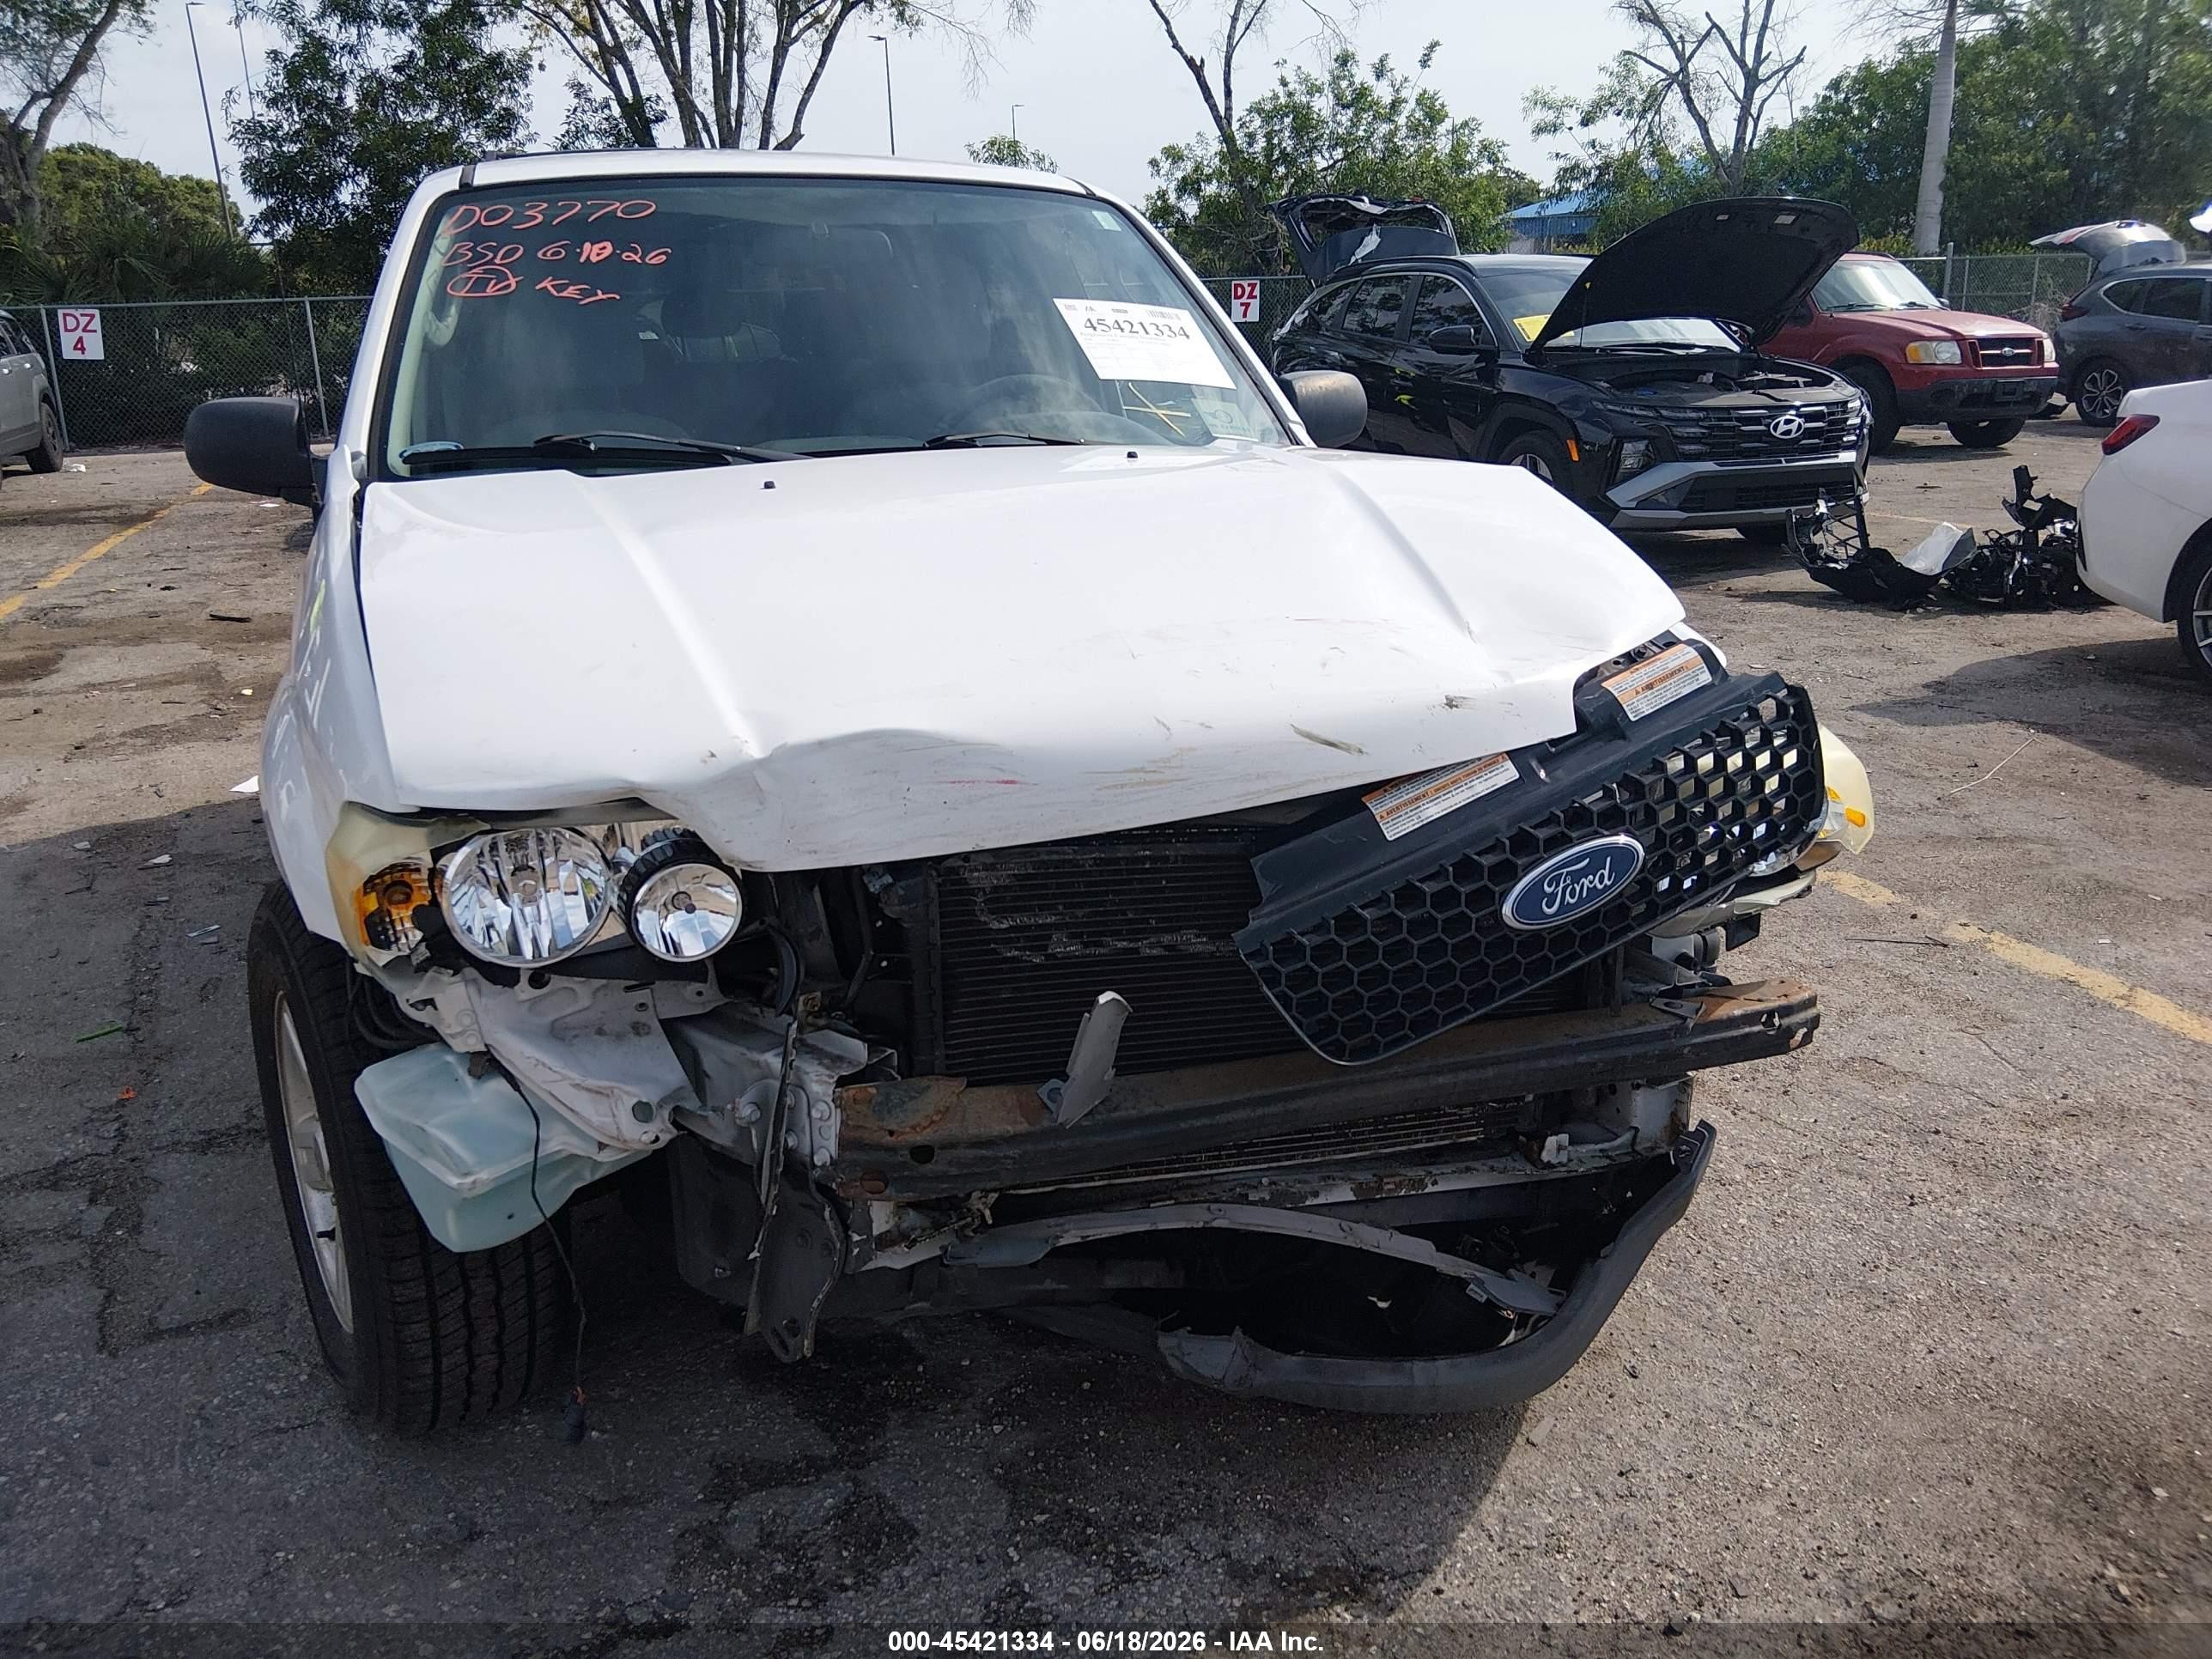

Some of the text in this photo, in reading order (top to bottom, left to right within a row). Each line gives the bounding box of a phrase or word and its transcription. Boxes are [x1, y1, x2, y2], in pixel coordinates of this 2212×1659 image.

[535, 276, 621, 305] KEY
[1233, 283, 1258, 300] DZ
[1239, 301, 1251, 319] 7
[62, 313, 97, 333] DZ
[1084, 318, 1190, 339] 45421334
[72, 336, 87, 355] 4
[1542, 856, 1615, 915] Ford
